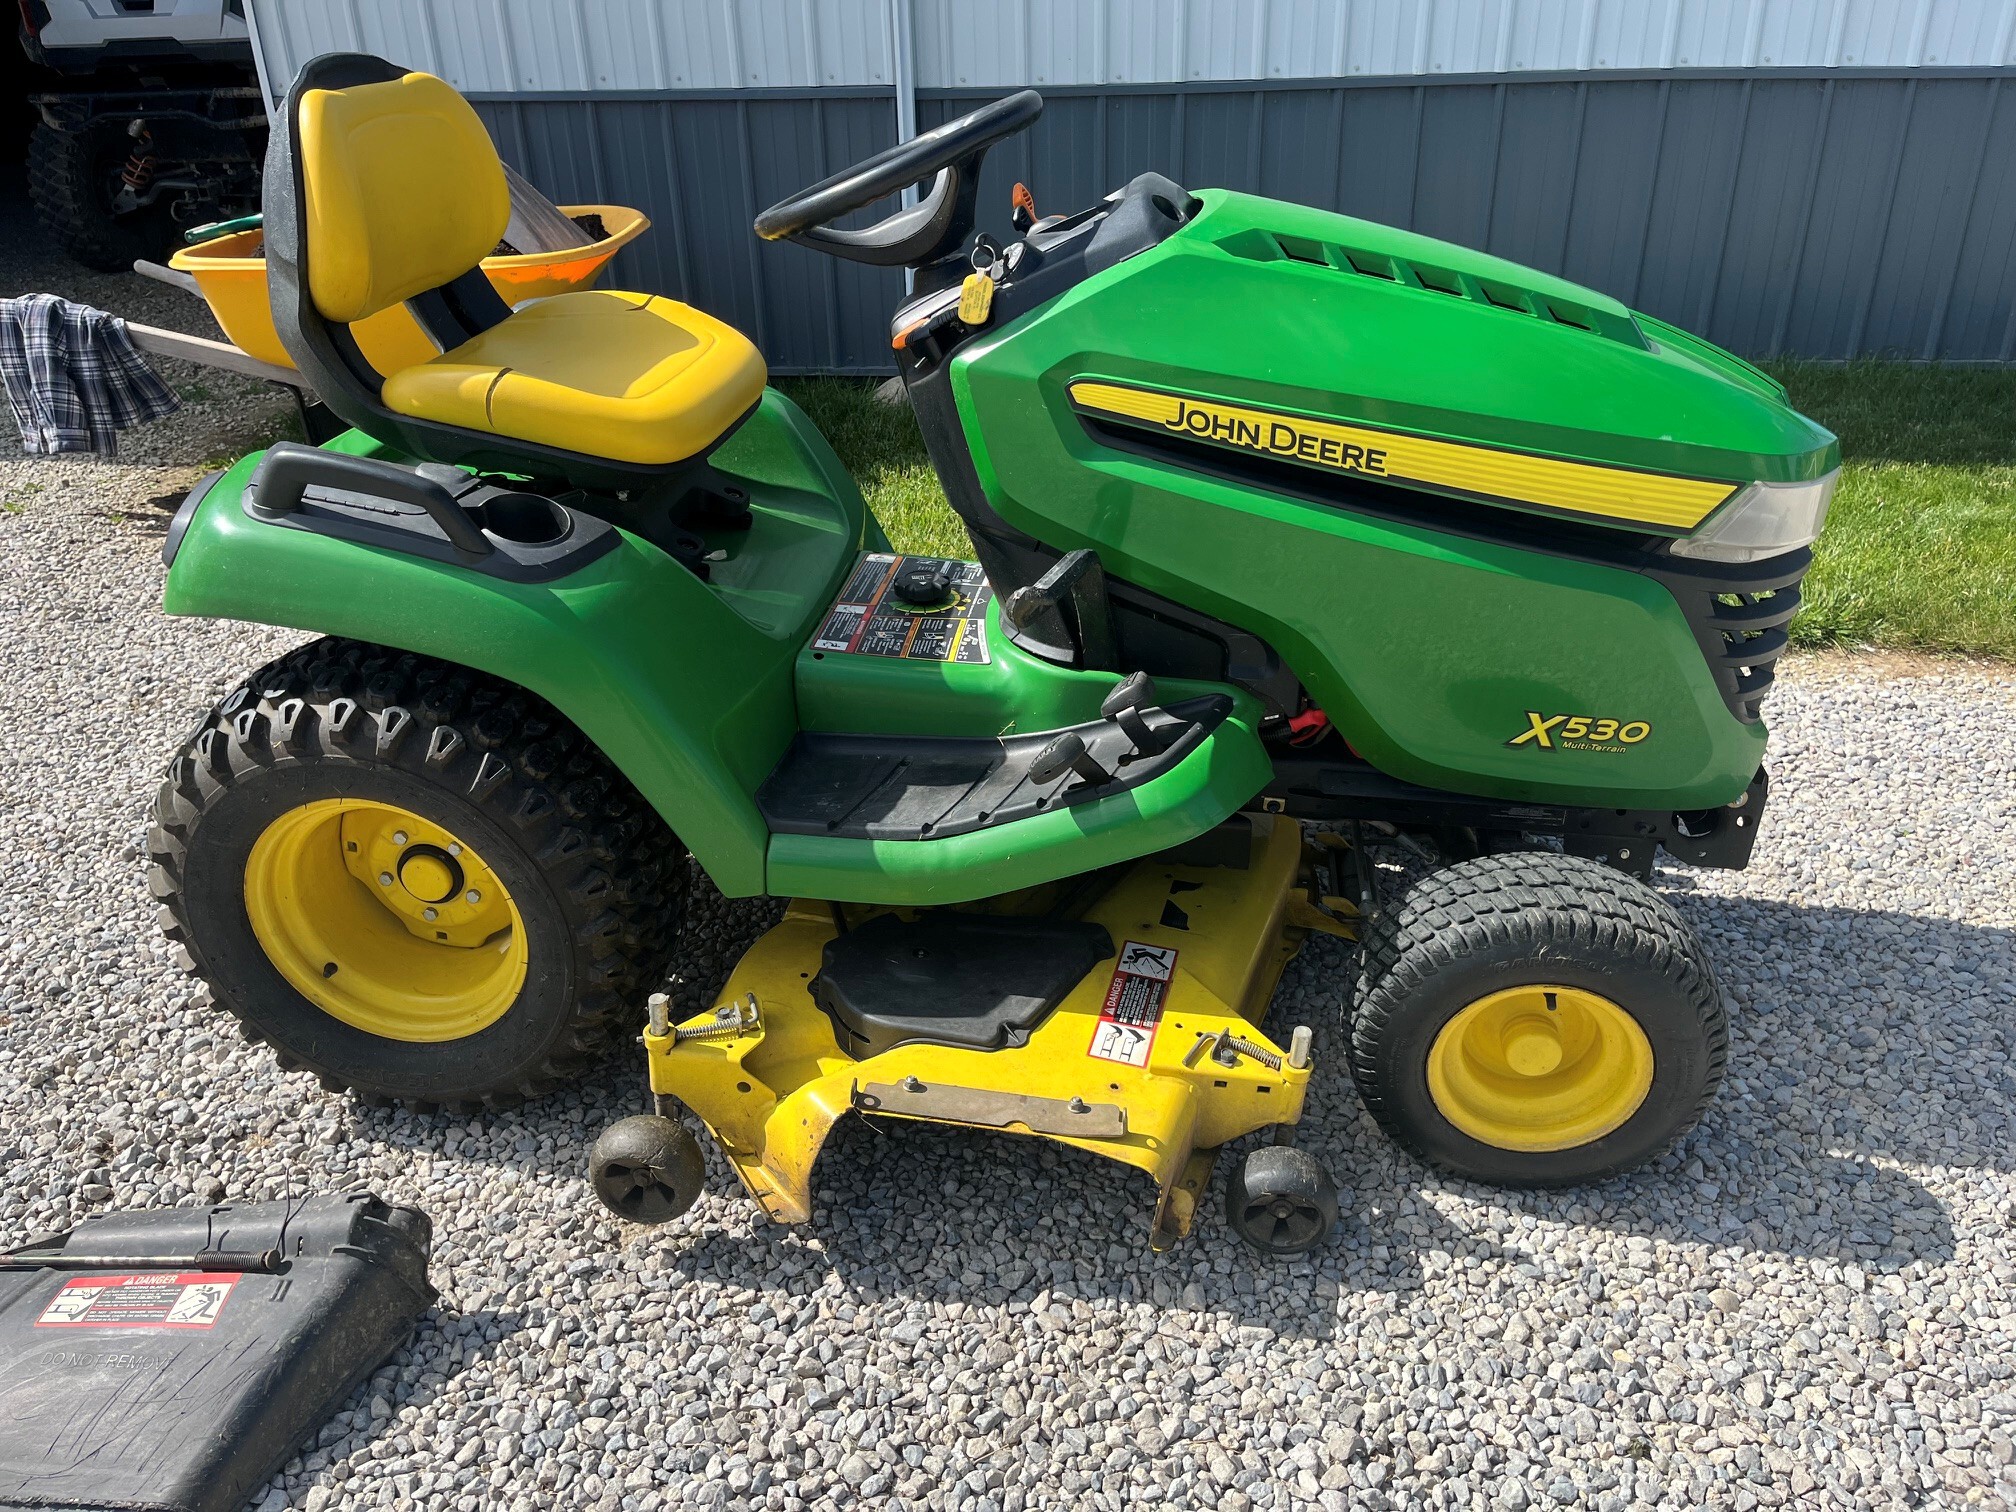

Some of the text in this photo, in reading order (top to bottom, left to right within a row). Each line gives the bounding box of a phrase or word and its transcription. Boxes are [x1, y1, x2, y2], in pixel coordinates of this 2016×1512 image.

[1165, 401, 1388, 474] JOHN DEERE
[1507, 711, 1652, 748] X530
[1561, 741, 1627, 754] Multi-Terrain
[1106, 977, 1123, 1006] DANGER
[133, 1275, 178, 1285] DANGER
[40, 1352, 66, 1366] DO
[67, 1353, 104, 1367] NOT
